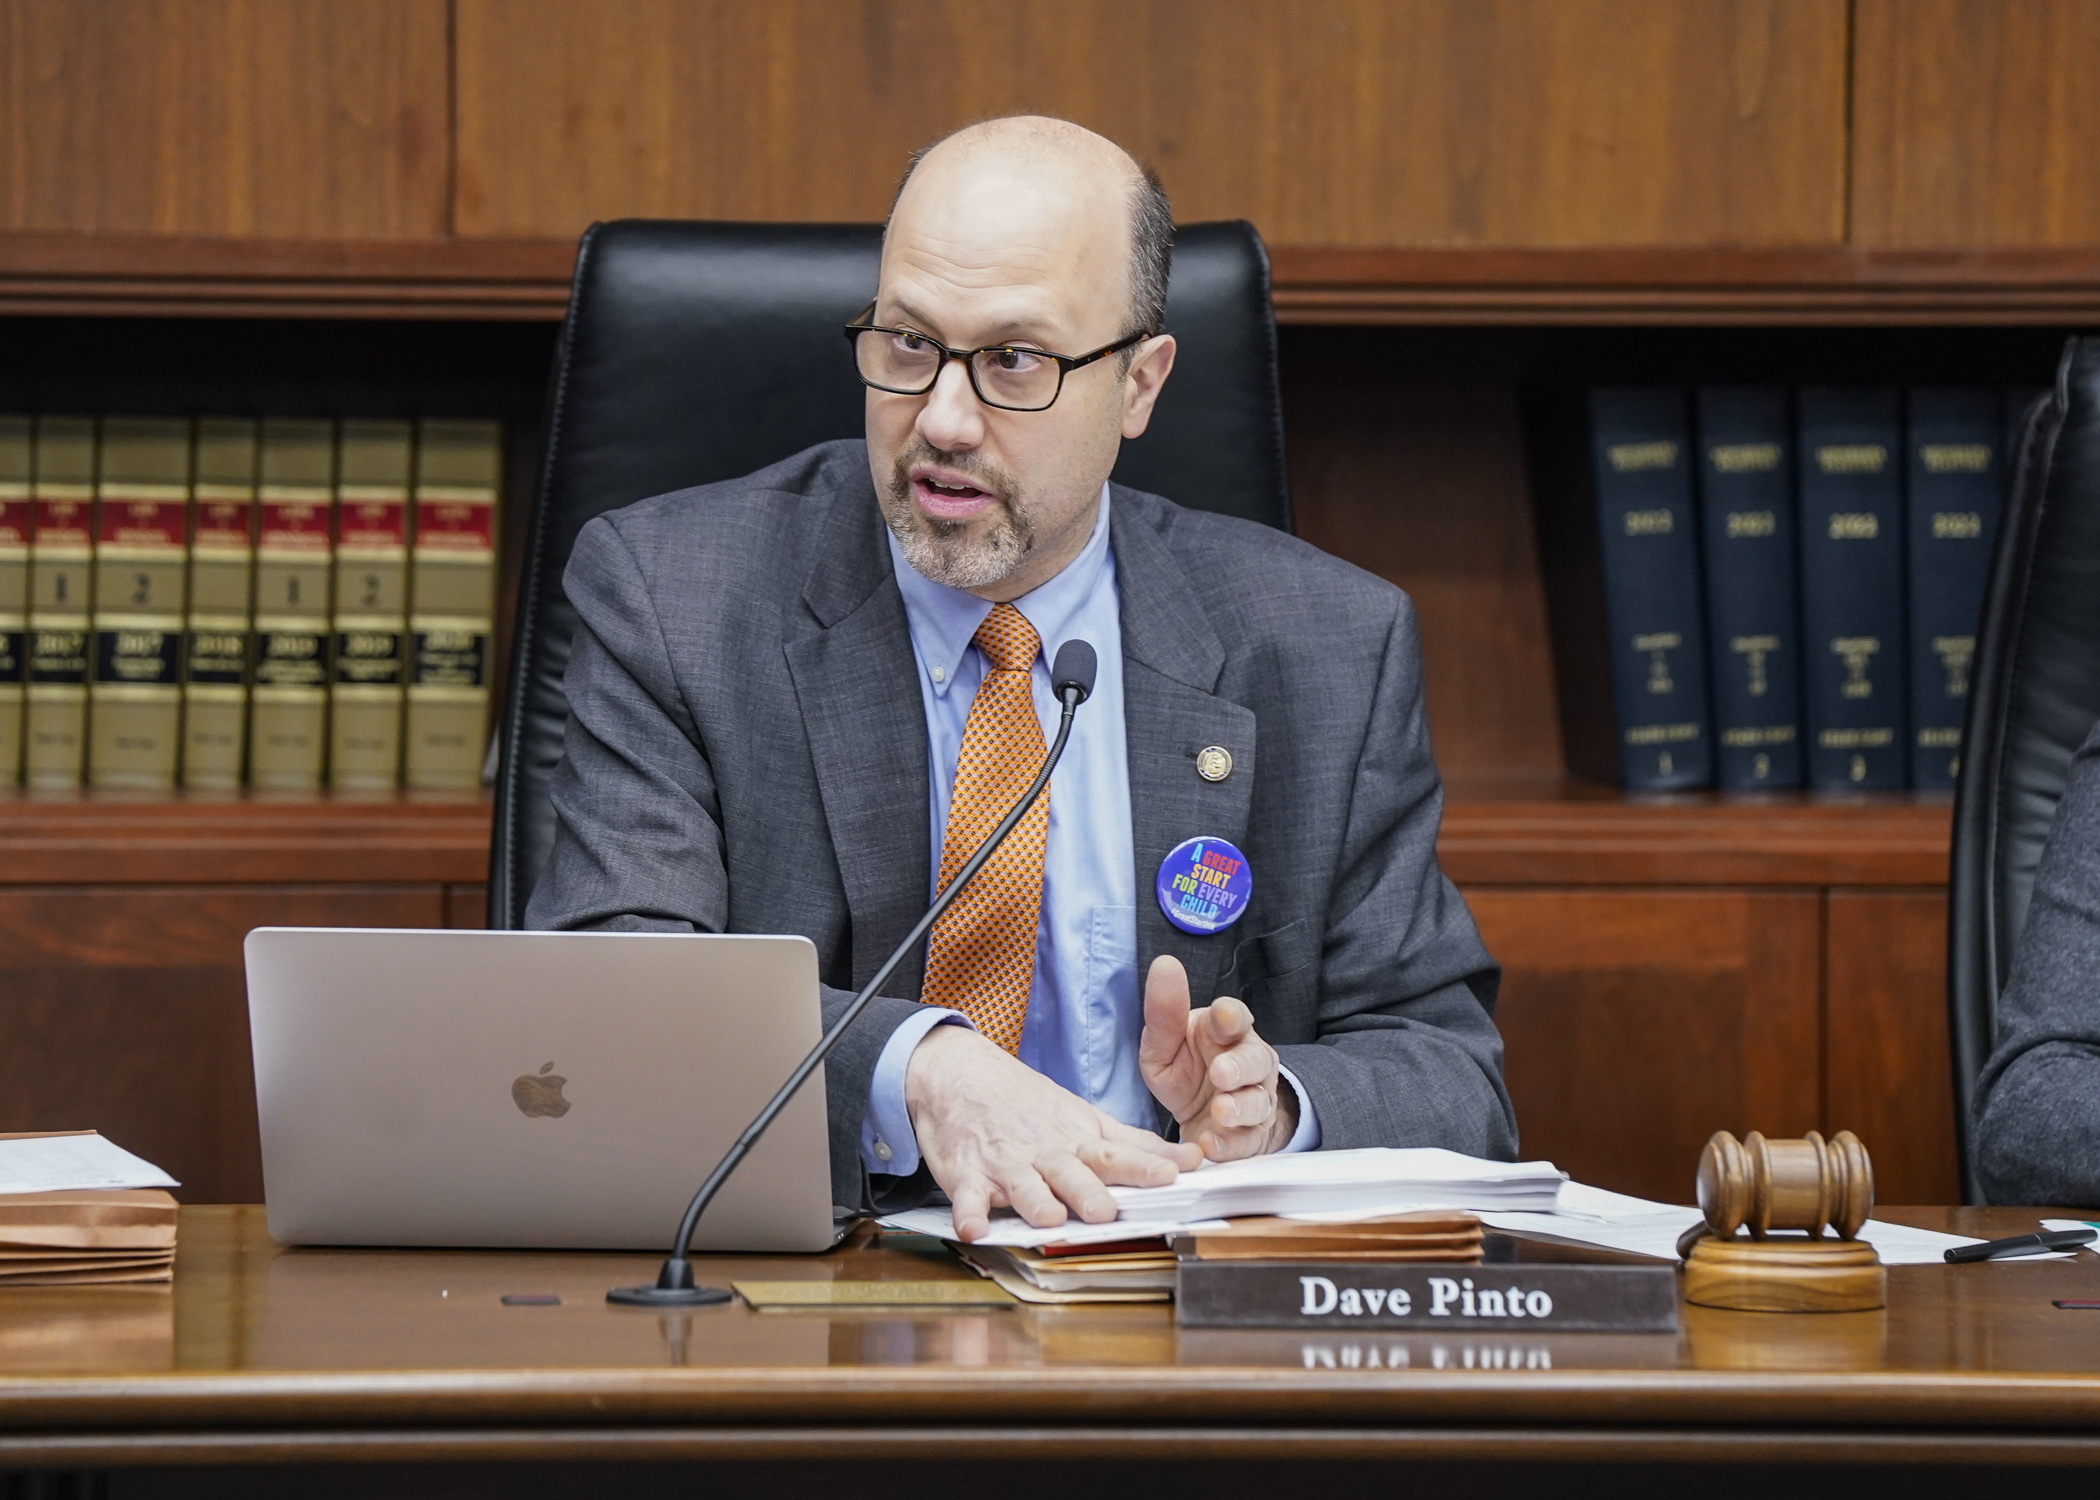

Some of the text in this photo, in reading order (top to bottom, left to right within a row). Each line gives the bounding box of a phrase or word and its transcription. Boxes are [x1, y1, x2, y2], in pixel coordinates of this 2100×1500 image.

[1190, 843, 1241, 876] A GREAT
[1191, 863, 1231, 889] START
[1172, 873, 1238, 909] FOR EVERY
[1180, 894, 1219, 919] CHILD
[1300, 1275, 1553, 1318] Dave Pinto
